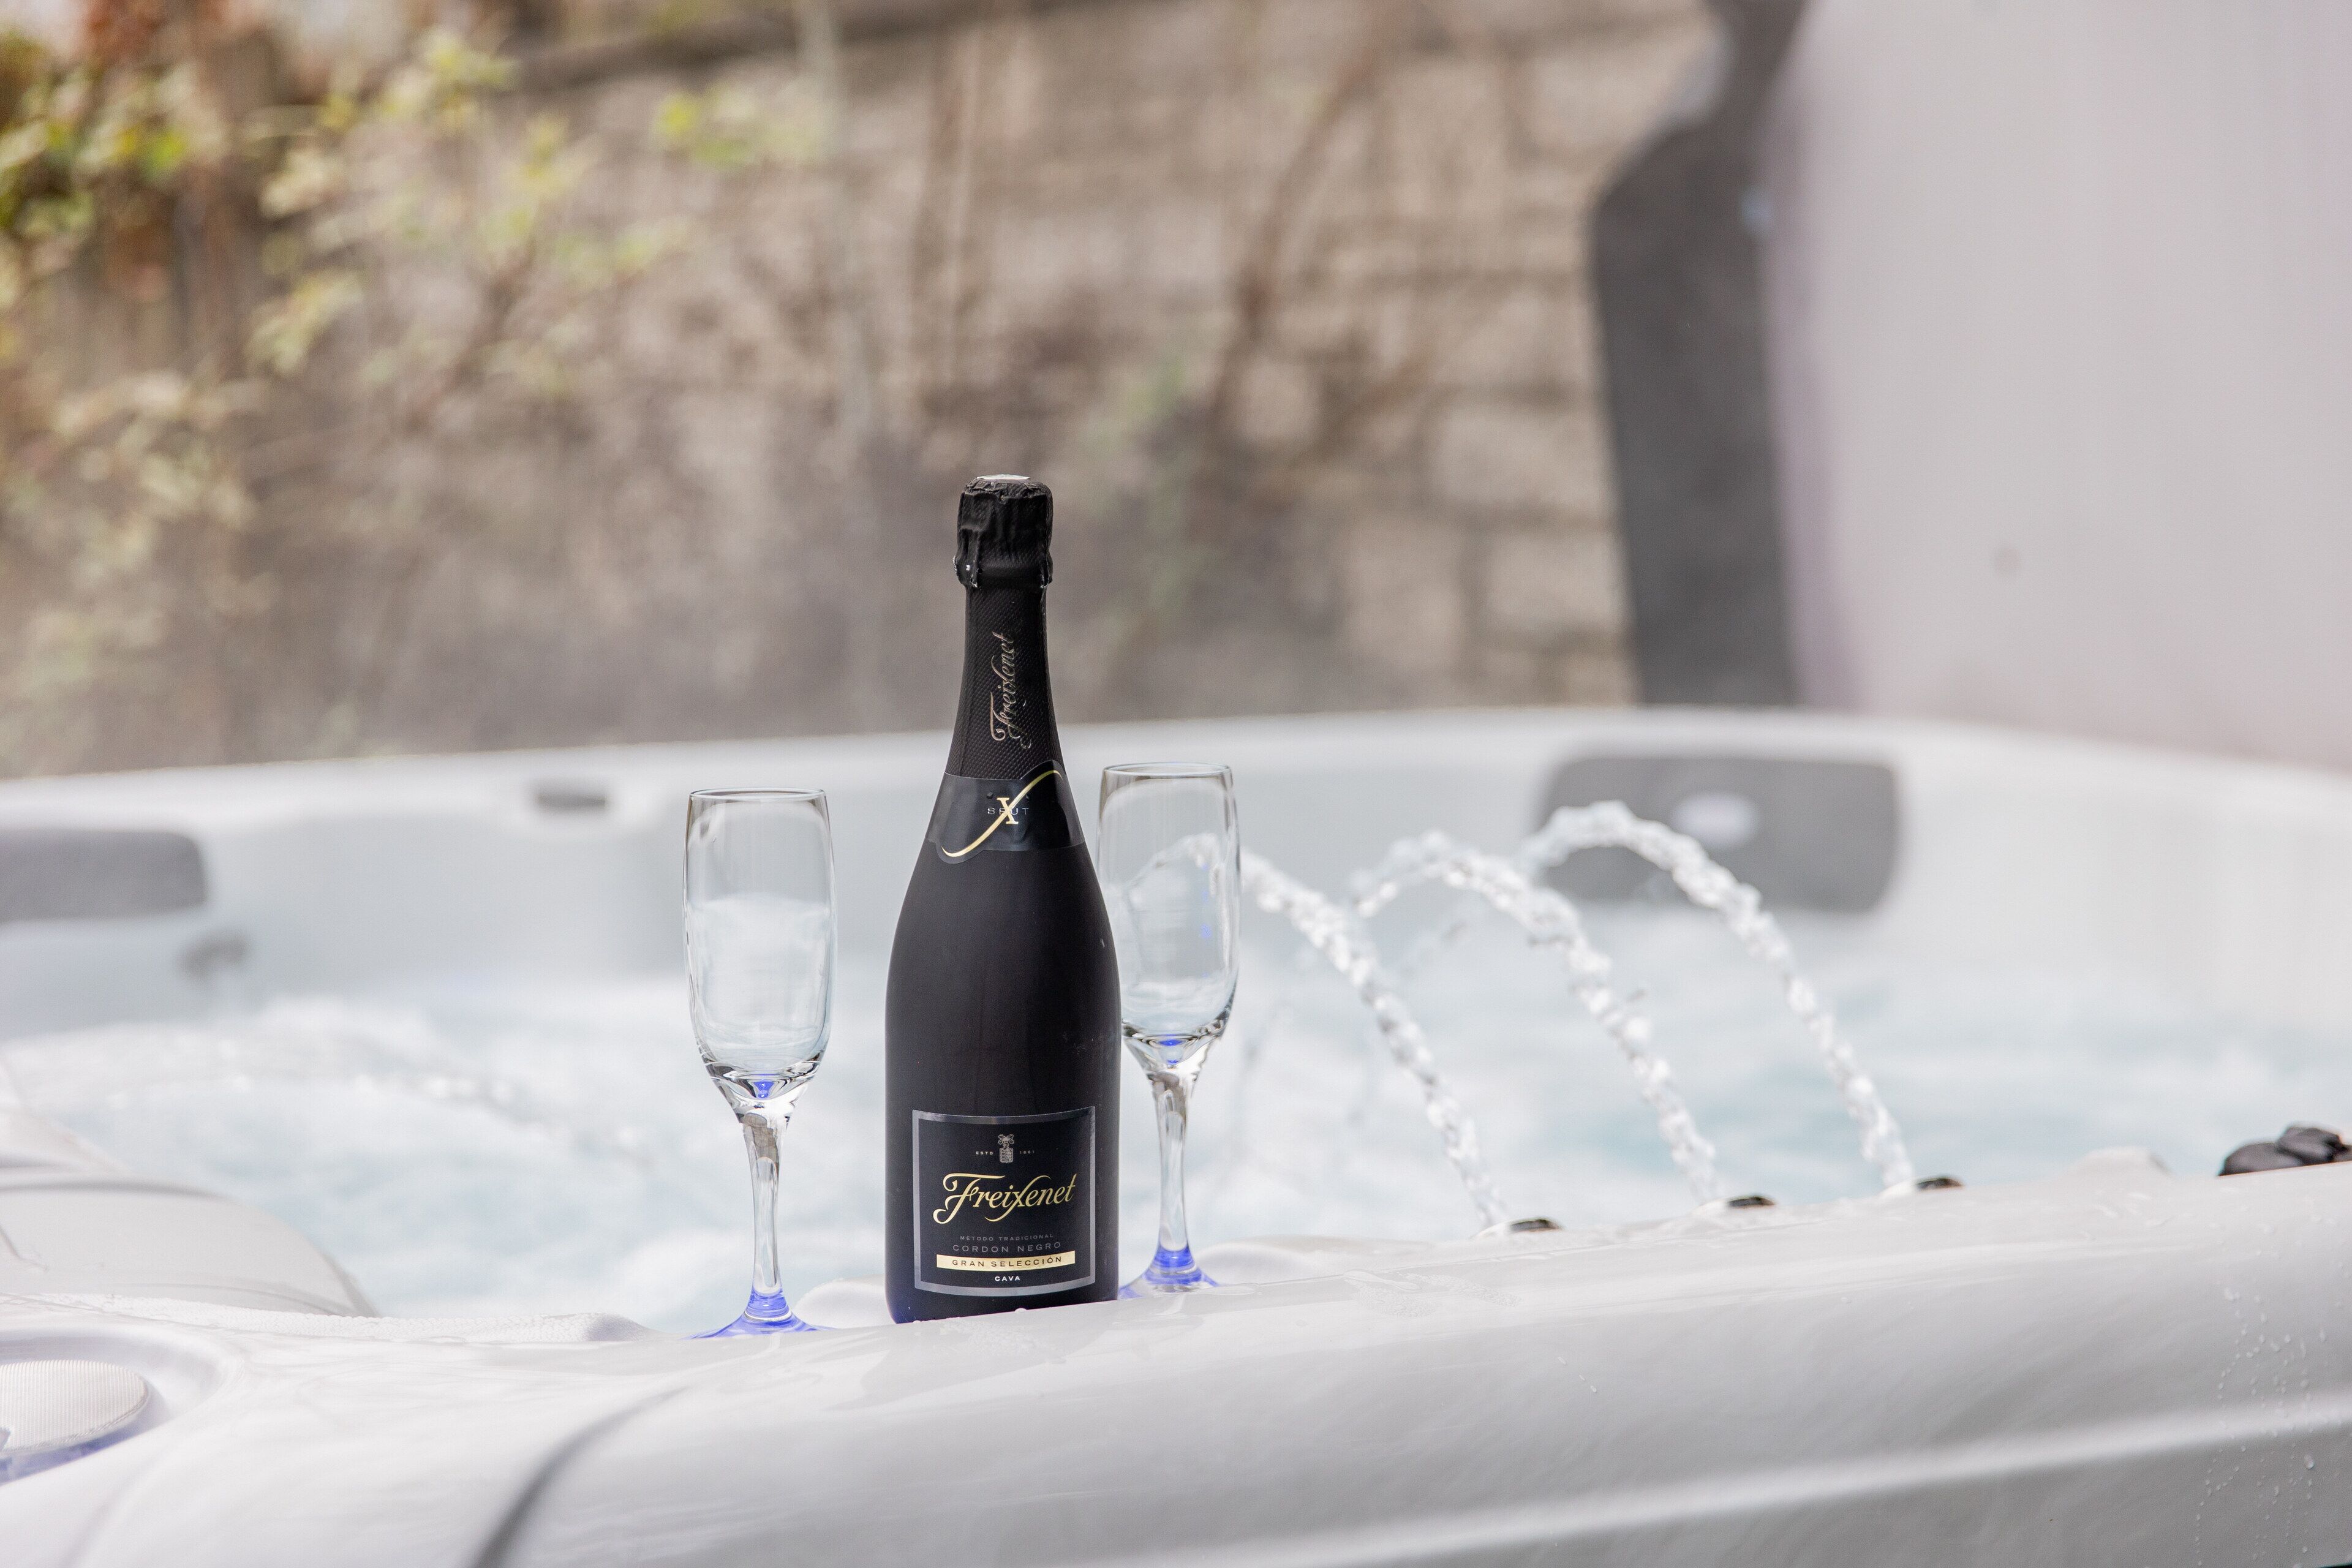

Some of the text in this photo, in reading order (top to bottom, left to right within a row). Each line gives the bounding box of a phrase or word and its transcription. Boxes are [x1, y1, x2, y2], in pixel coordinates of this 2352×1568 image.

[990, 631, 1031, 749] Freixenet
[932, 1172, 1077, 1224] Freixenet
[991, 1256, 1062, 1267] SELECCIÓN
[1017, 1242, 1061, 1252] NEGRO
